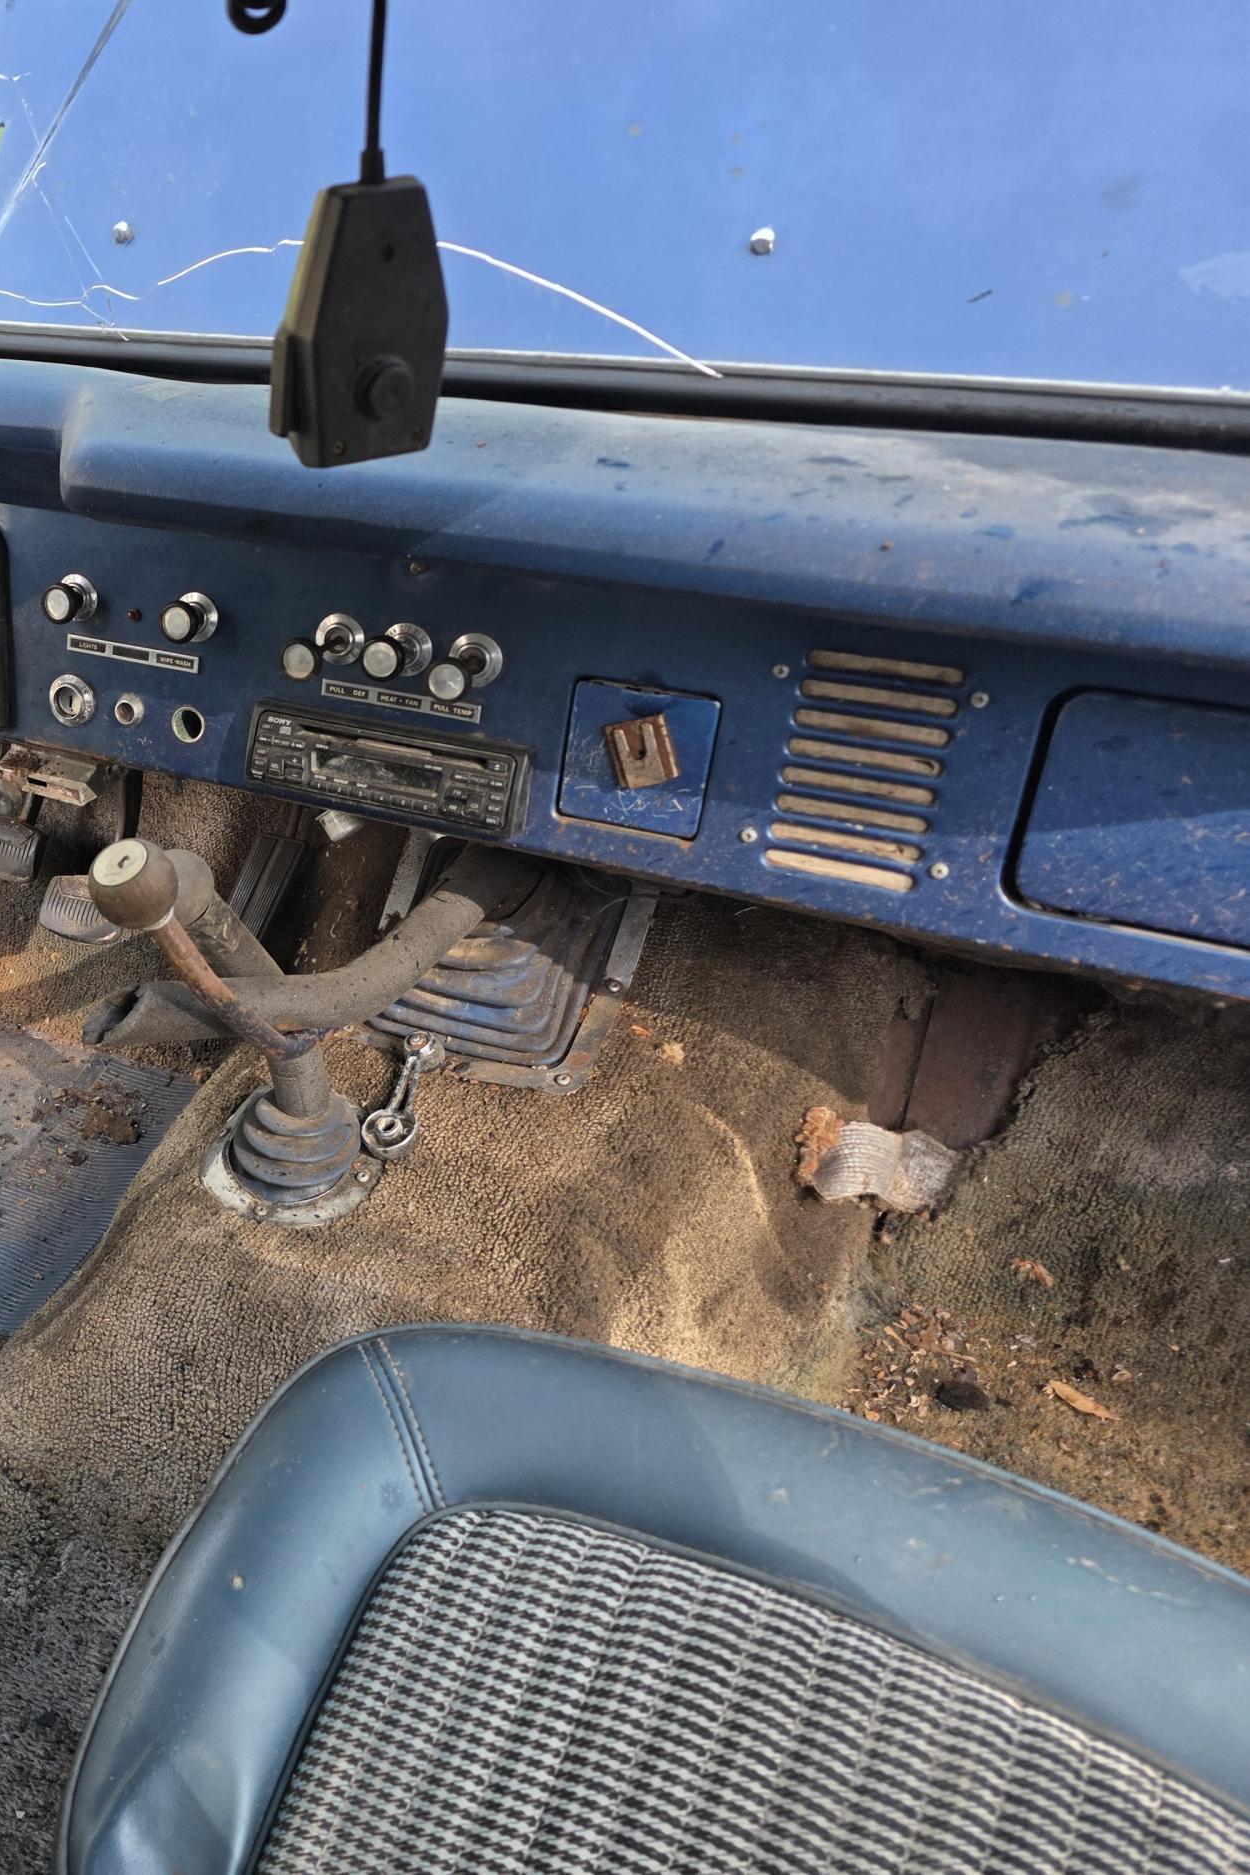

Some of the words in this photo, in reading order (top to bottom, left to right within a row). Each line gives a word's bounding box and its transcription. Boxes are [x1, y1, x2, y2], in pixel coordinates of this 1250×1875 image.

[78, 641, 98, 650] LIGHTS
[329, 686, 346, 695] PULL
[352, 689, 366, 697] DEF
[380, 694, 397, 702] HEAT
[405, 698, 419, 707] FAN
[433, 703, 450, 713] PULL
[453, 707, 473, 716] TEMP
[267, 716, 292, 726] SONY
